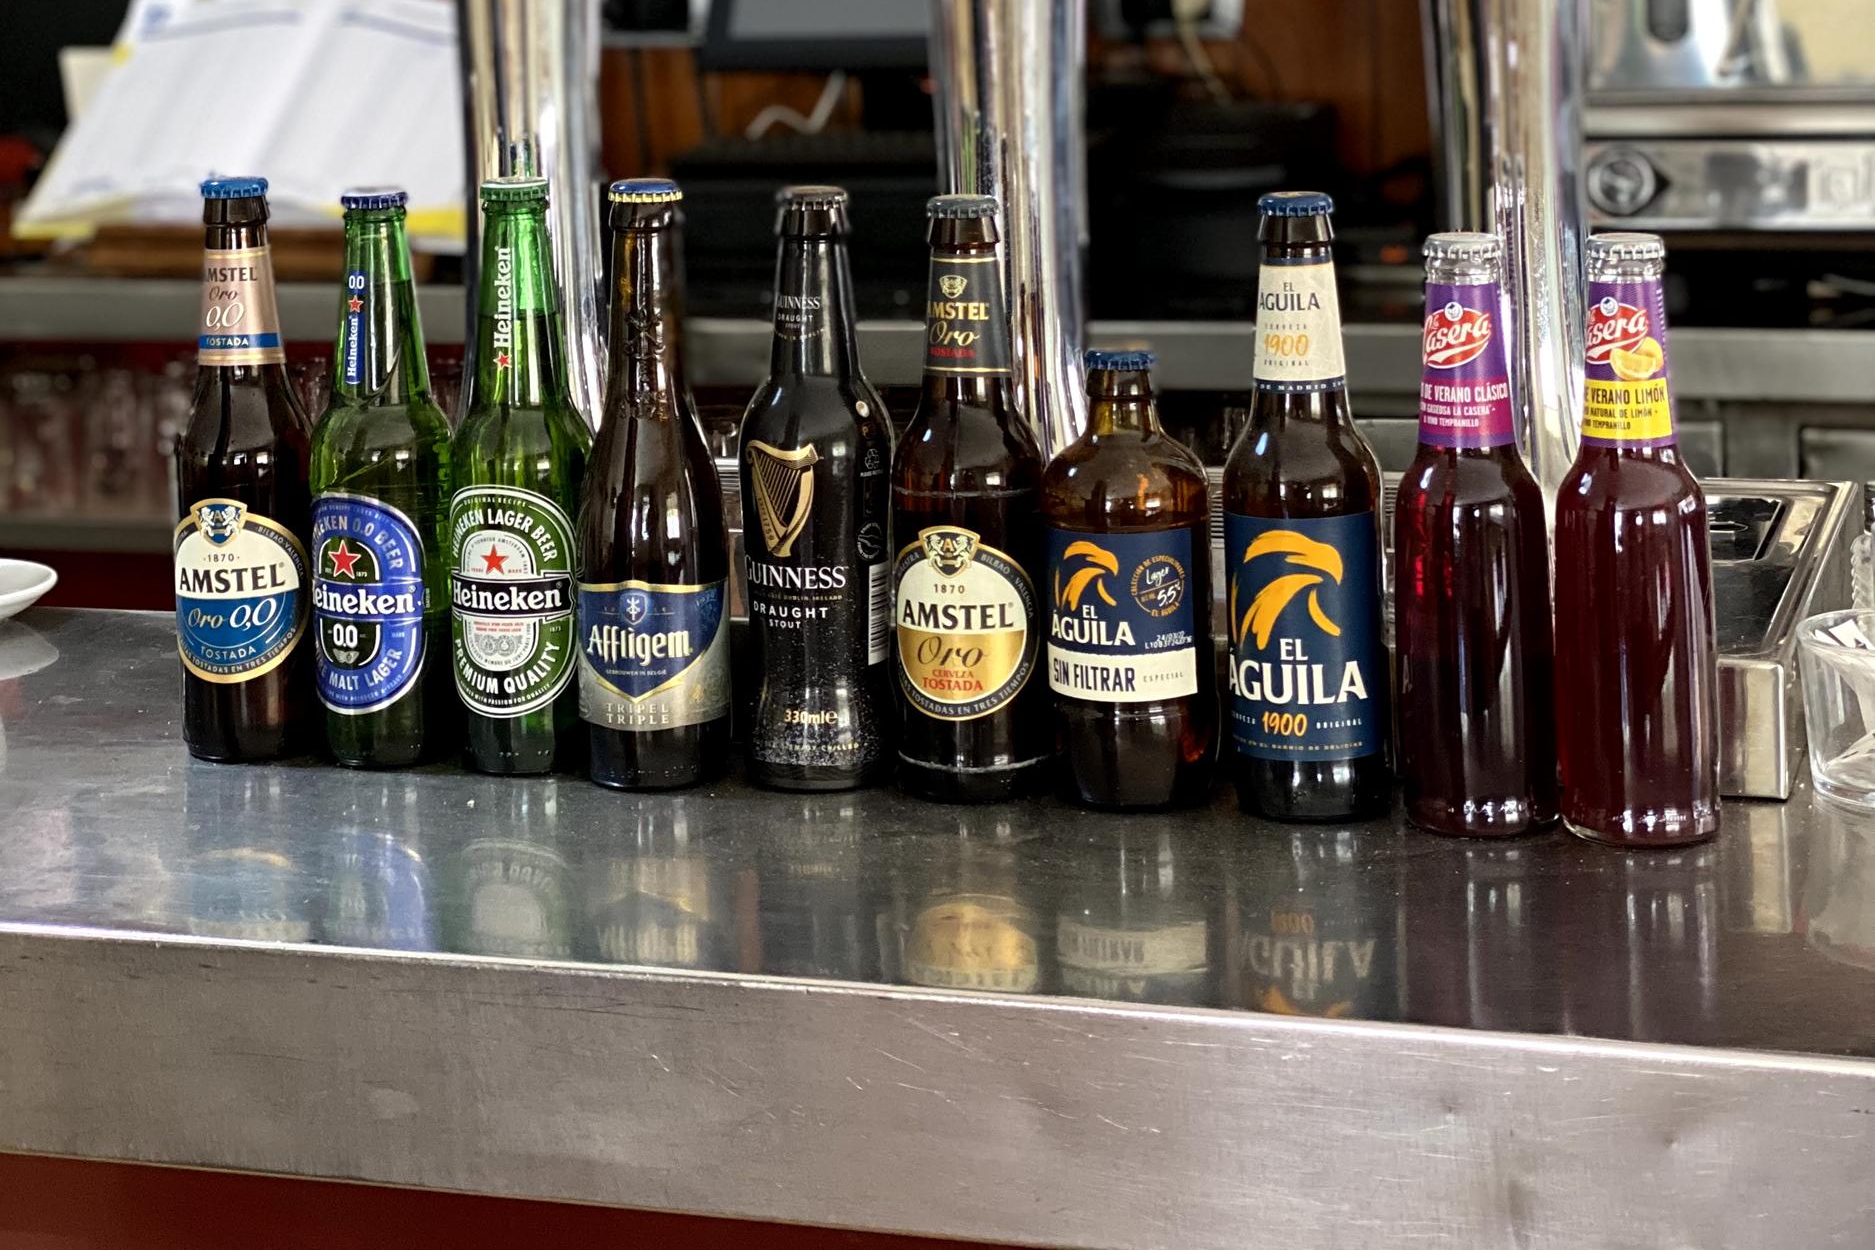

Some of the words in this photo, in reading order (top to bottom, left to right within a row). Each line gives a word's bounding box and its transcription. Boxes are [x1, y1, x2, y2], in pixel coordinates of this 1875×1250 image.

[206, 267, 257, 282] MSTEL
[209, 286, 238, 301] Oro
[493, 247, 511, 349] Heineken
[1283, 282, 1294, 292] EL
[777, 295, 821, 310] UINNESS
[206, 337, 249, 346] TOSTADA
[929, 320, 980, 347] Oro
[1264, 333, 1309, 356] 1900
[347, 317, 359, 377] Heineken
[1278, 382, 1327, 391] MADRID
[1434, 384, 1471, 403] VERANO
[1474, 381, 1509, 402] CLÁSICO
[1591, 388, 1630, 405] VERANO
[1635, 382, 1665, 404] LIMÓN
[1453, 406, 1462, 416] LA
[1590, 407, 1616, 419] NATURAL
[1619, 409, 1628, 419] DE
[452, 508, 485, 559] HEINEKEN
[487, 508, 534, 534] LAGER
[530, 524, 558, 563] BEER
[207, 554, 235, 563] 1870
[374, 529, 404, 571] BEER
[745, 554, 847, 589] GUINNESS
[980, 552, 1010, 575] BILBAO
[179, 563, 287, 594] AMSTEL
[933, 584, 965, 595] 1870
[452, 580, 563, 612] Heineken
[188, 607, 224, 629] Oro
[753, 600, 829, 619] DRAUGHT
[902, 599, 1014, 630] AMSTEL
[1082, 605, 1098, 619] EL
[769, 618, 801, 629] STOUT
[1051, 608, 1136, 646] ÁGUILA
[333, 623, 358, 648] 0.0
[586, 624, 690, 667] Affligem
[200, 645, 257, 661] TOSTADA
[917, 635, 985, 669] Oro
[1279, 638, 1308, 661] EL
[329, 671, 359, 691] MALT
[364, 648, 403, 688] LAGER
[454, 638, 499, 695] PREMIUM
[503, 641, 560, 694] QUALITY
[931, 669, 974, 679] CERVEZA
[1053, 657, 1070, 687] SIN
[1073, 664, 1136, 692] FILTRAR
[1143, 671, 1184, 683] ESPECIAL
[1228, 646, 1368, 705] ÁGUILA
[911, 688, 955, 716] TOSTADAS
[957, 704, 972, 715] EN
[974, 696, 999, 712] TRES
[999, 661, 1030, 699] TIEMPOS
[921, 677, 984, 691] TOSTADA
[606, 702, 669, 714] TRIPEL
[606, 713, 670, 725] TRIPLE
[1262, 711, 1307, 737] 1900
[1316, 717, 1362, 729] ORIGINAL
